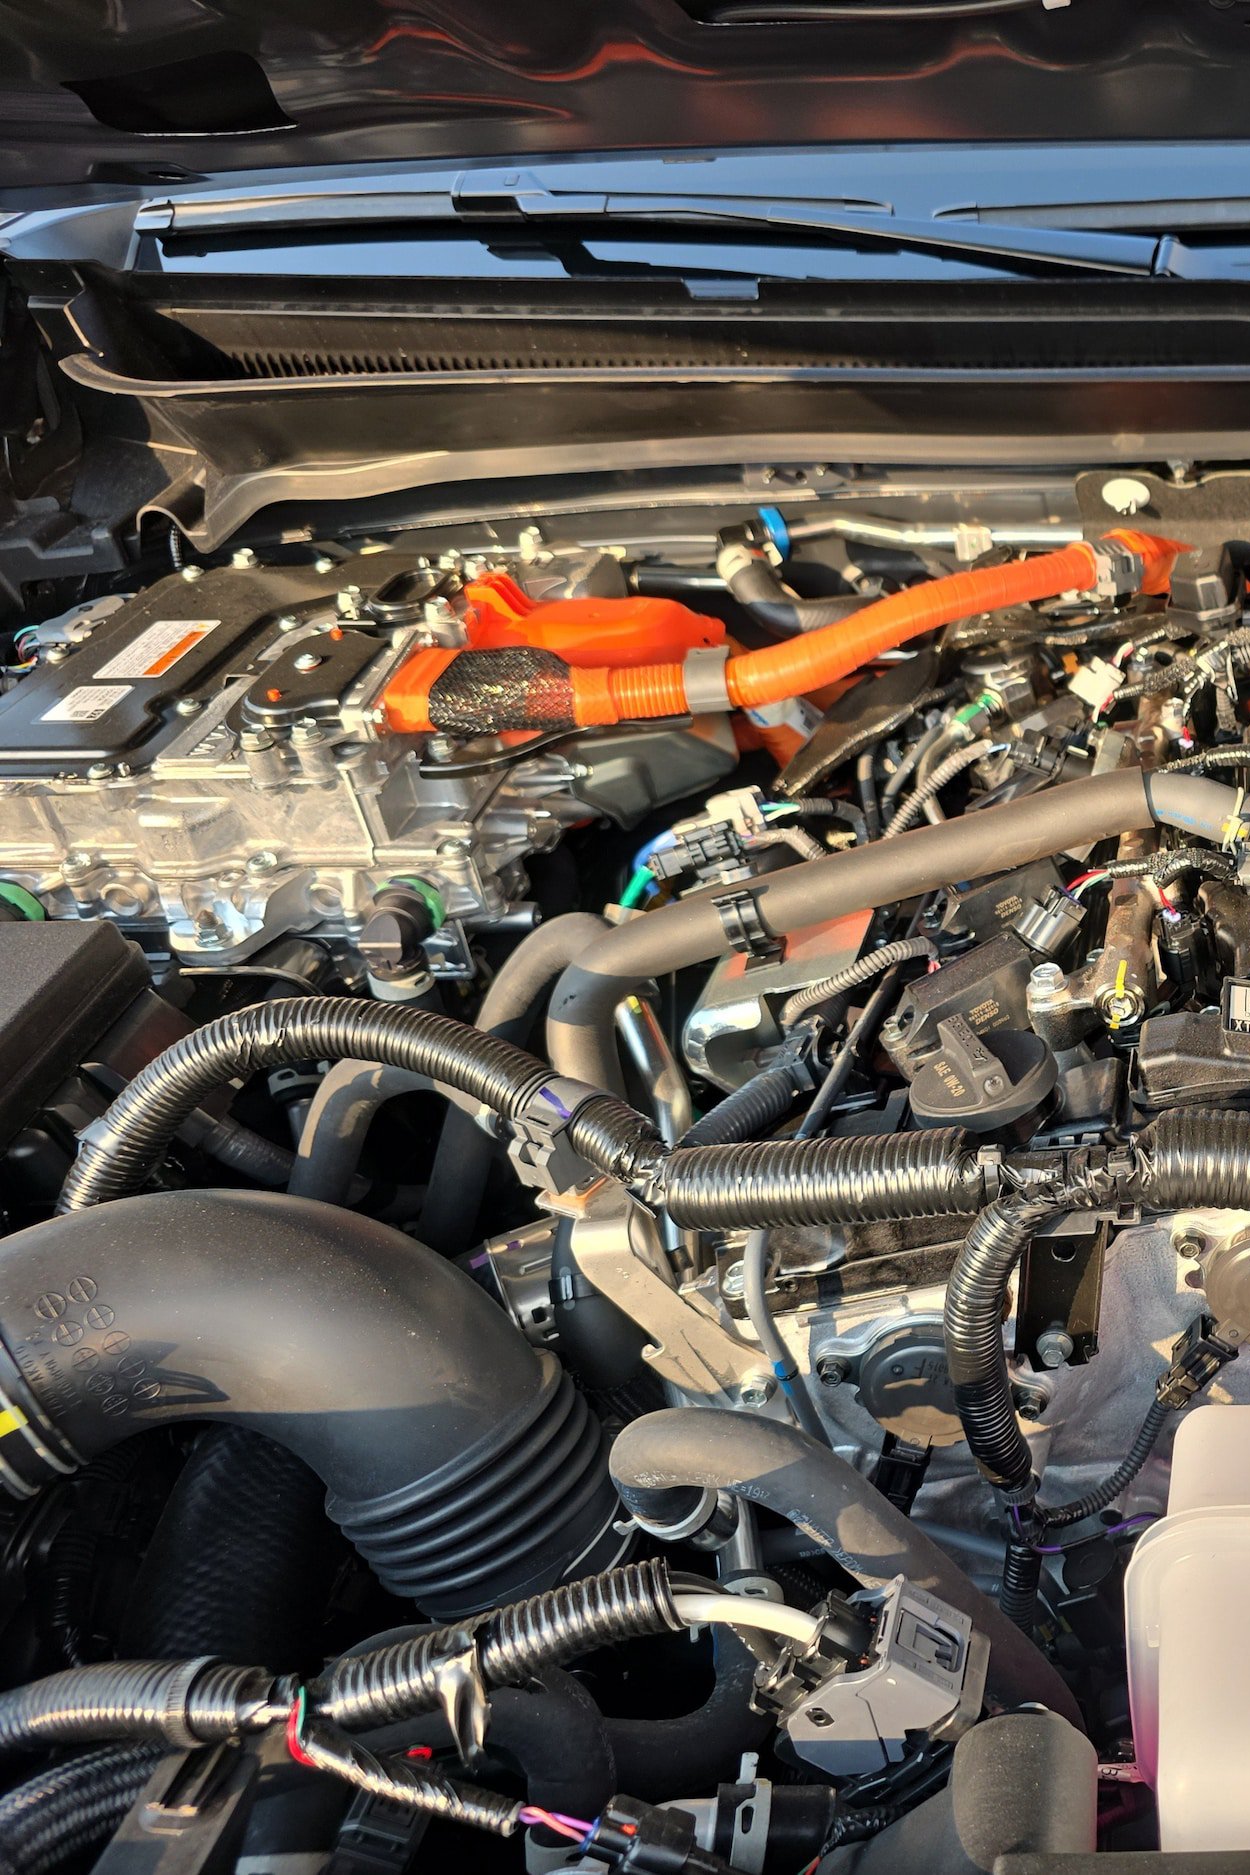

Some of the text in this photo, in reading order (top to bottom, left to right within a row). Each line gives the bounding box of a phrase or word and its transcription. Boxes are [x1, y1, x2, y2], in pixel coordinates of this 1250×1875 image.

[969, 999, 995, 1014] TOYOTA
[933, 1061, 952, 1077] SAE
[944, 1075, 966, 1097] 0W-20
